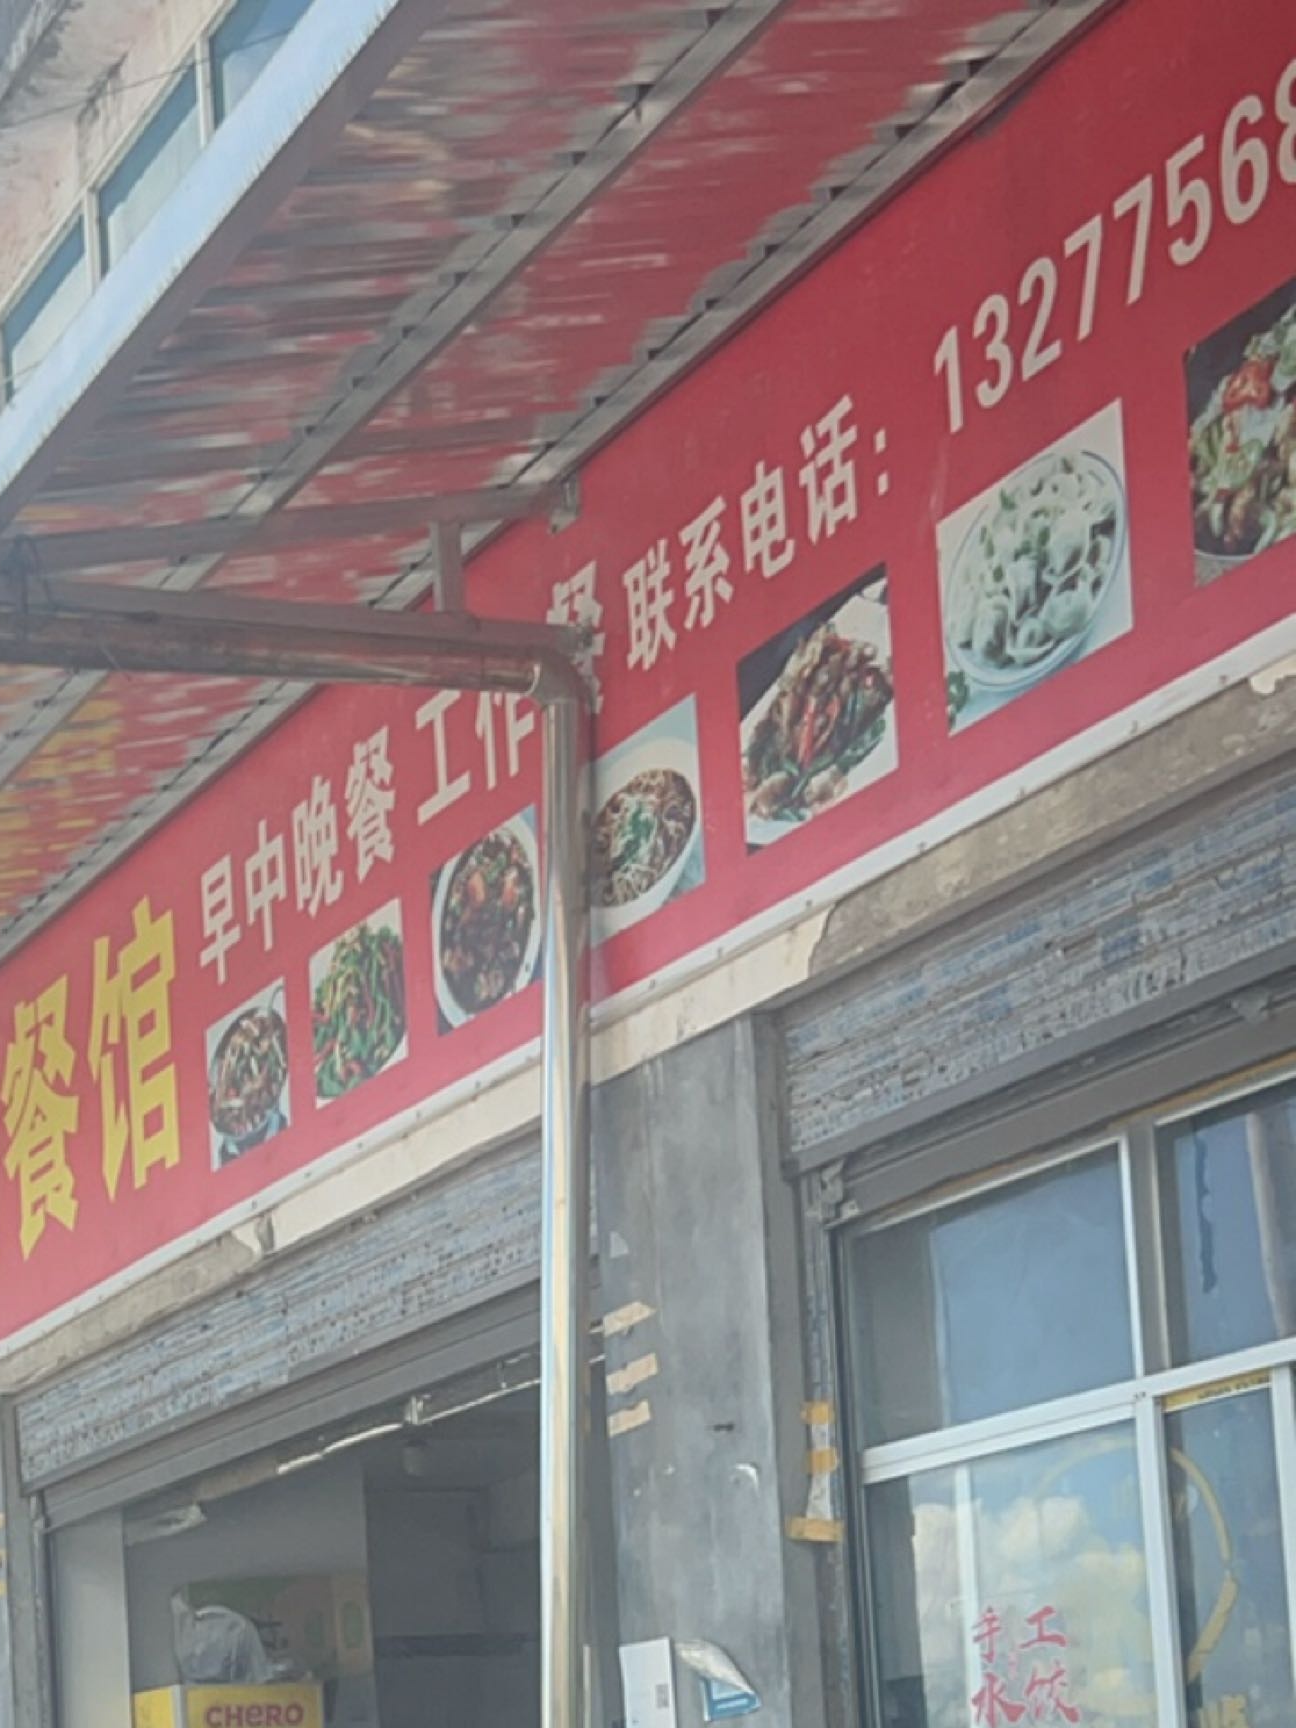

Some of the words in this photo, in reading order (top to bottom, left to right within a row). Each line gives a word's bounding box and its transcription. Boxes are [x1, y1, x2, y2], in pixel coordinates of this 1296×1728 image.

[199, 725, 396, 985] 早中晚餐
[622, 396, 890, 672] 联系电话：
[972, 1605, 1068, 1664] 手工
